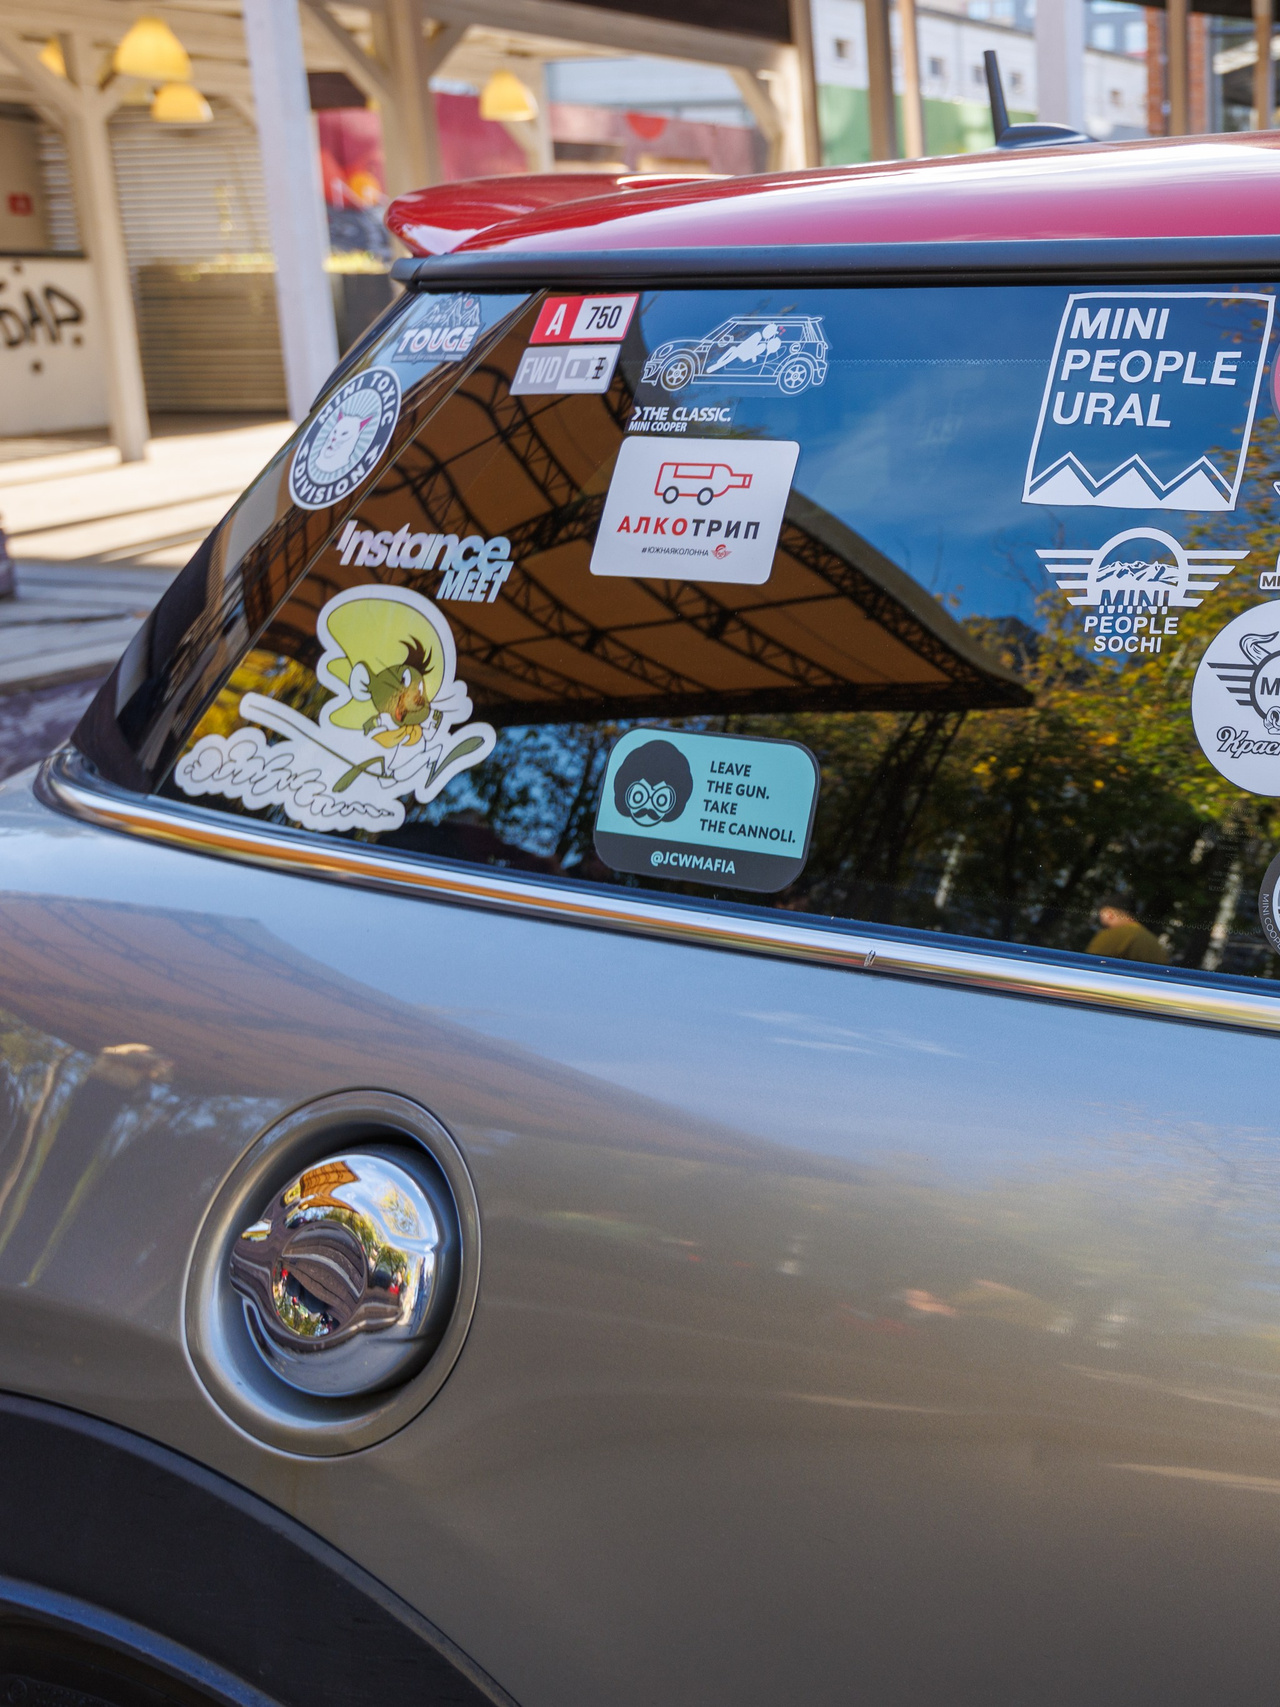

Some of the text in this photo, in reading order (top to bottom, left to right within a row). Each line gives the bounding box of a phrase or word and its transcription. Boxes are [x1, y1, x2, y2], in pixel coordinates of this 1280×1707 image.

[545, 303, 623, 336] A 750
[1069, 307, 1170, 340] MINI
[397, 326, 479, 353] TOUGE
[517, 356, 562, 384] FWD
[1060, 349, 1242, 386] PEOPLE
[319, 372, 396, 427] MINI TOXIC
[1052, 391, 1171, 428] URAL
[628, 421, 687, 433] MINI COOPER
[643, 406, 732, 422] THE CLASSIC.
[294, 464, 366, 503] DIVISION
[617, 515, 760, 540] АЛКОТРИП
[336, 519, 512, 573] Instance
[435, 560, 514, 604] MEET
[1098, 589, 1170, 615] MINI
[1084, 615, 1179, 635] PEOPLE
[1093, 635, 1162, 653] SOCHI
[709, 760, 752, 778] LEAVE
[706, 779, 771, 800] THE GUN.
[703, 799, 738, 815] TAKE
[699, 818, 796, 844] THE CANNOLI.
[650, 850, 736, 875] @JCWMAFIA
[1262, 893, 1270, 916] MINI
